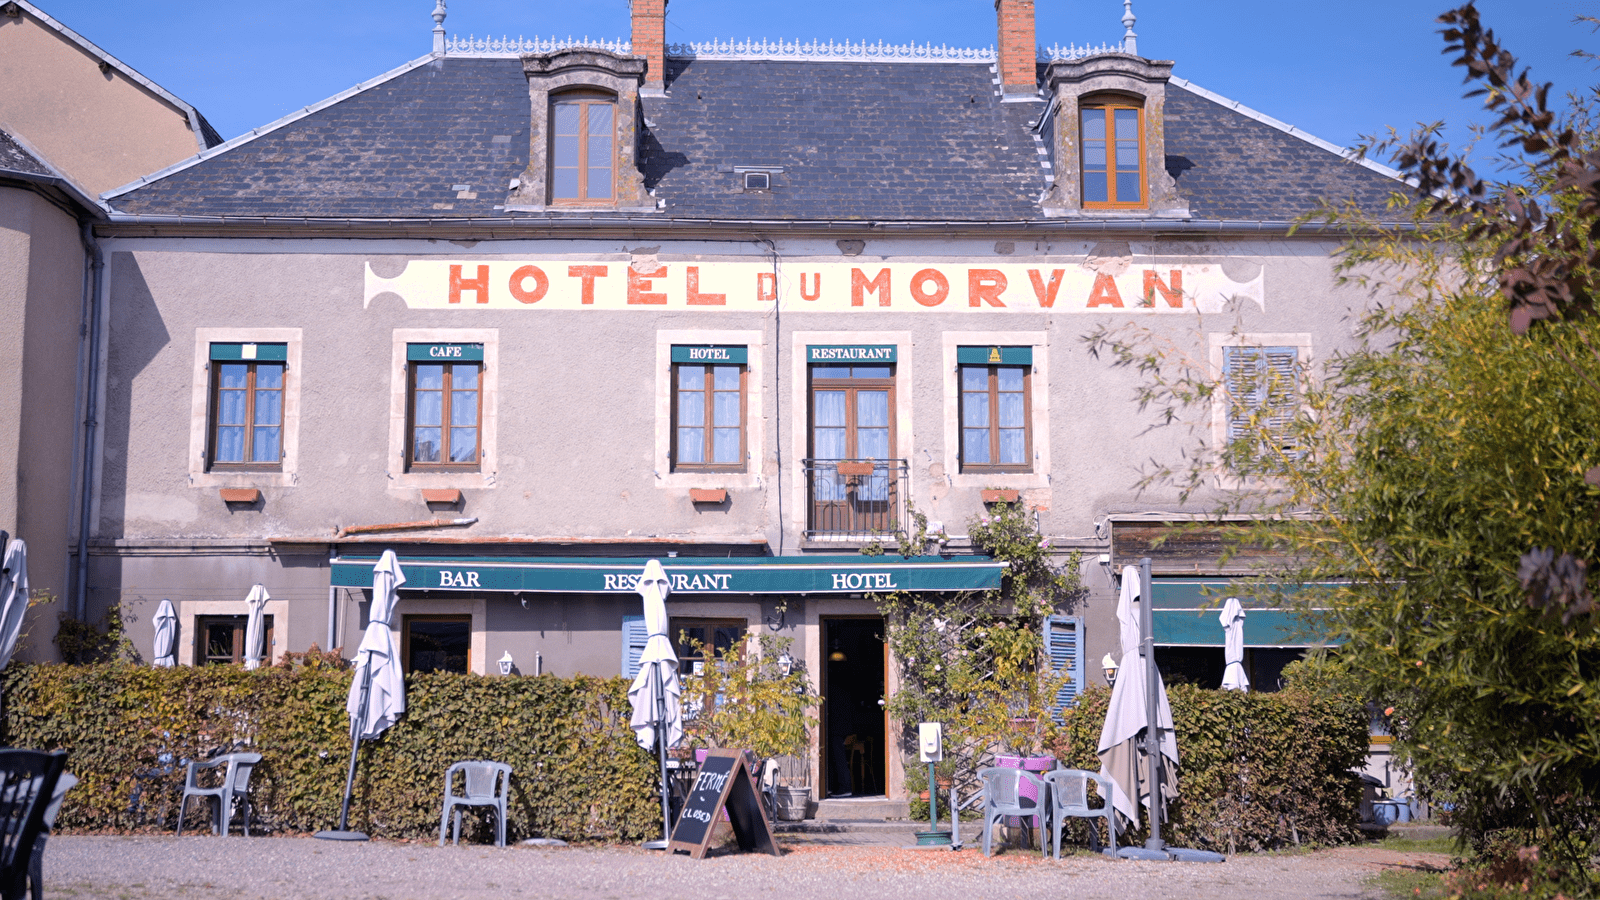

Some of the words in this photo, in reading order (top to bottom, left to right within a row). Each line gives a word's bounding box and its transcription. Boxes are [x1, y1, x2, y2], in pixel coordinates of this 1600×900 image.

[448, 264, 726, 305] HOTEL
[757, 272, 821, 301] DU
[851, 268, 1183, 308] MORVAN
[430, 346, 462, 357] CAFE
[689, 348, 730, 360] HOTEL
[811, 348, 891, 359] RESTAURANT
[439, 570, 481, 588] BAR
[831, 573, 897, 589] HOTEL
[693, 771, 730, 793] FERMÉ
[683, 808, 711, 823] CLOSED
